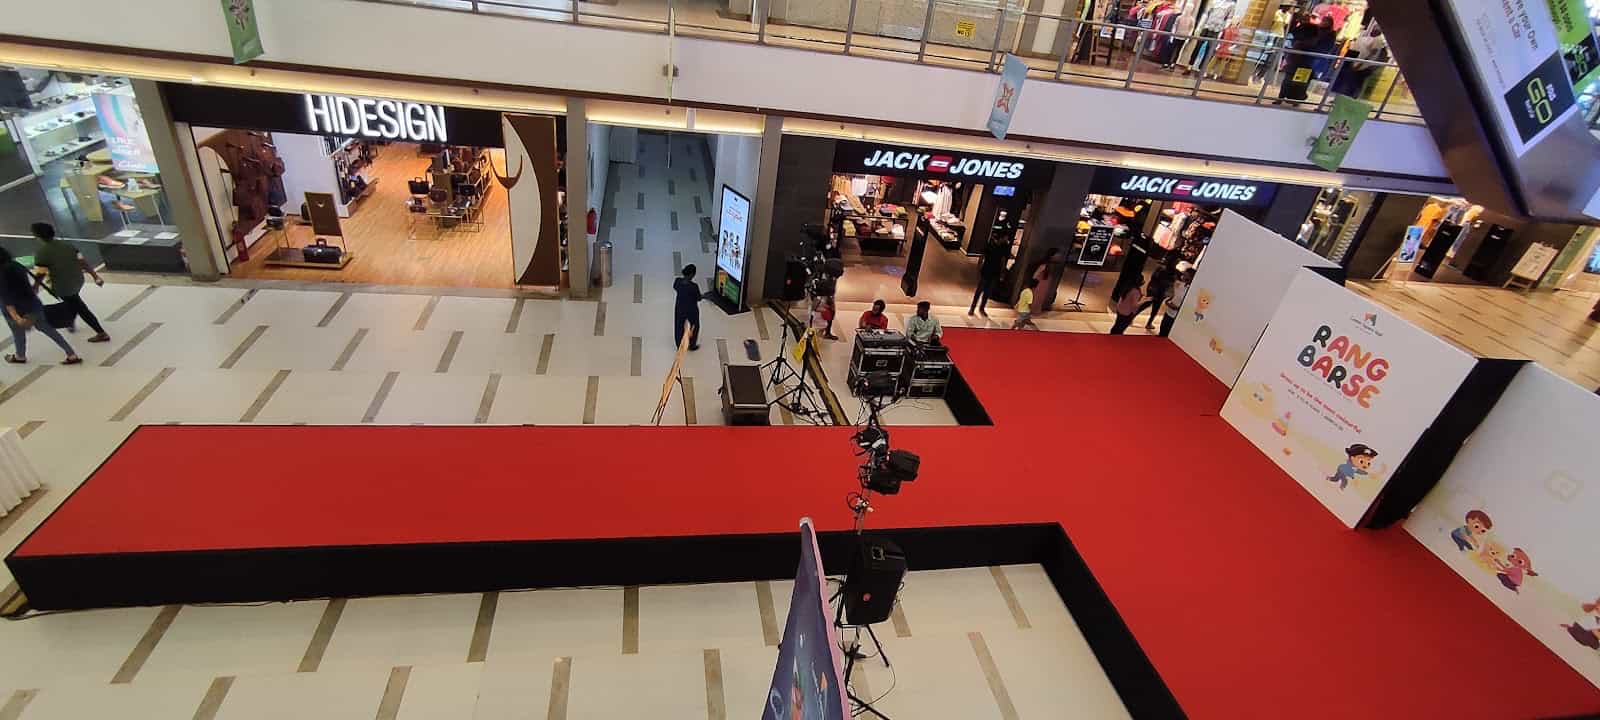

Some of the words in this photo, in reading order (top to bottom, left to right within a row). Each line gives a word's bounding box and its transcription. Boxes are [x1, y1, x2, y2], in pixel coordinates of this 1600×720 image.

[305, 94, 448, 142] HIDESIGN
[1527, 77, 1553, 124] GO
[864, 150, 931, 171] JACK
[950, 158, 1024, 179] JONES
[1121, 175, 1178, 194] JACK
[1192, 182, 1257, 201] JONES
[1297, 344, 1381, 409] BARSE
[1312, 325, 1390, 381] RANG
